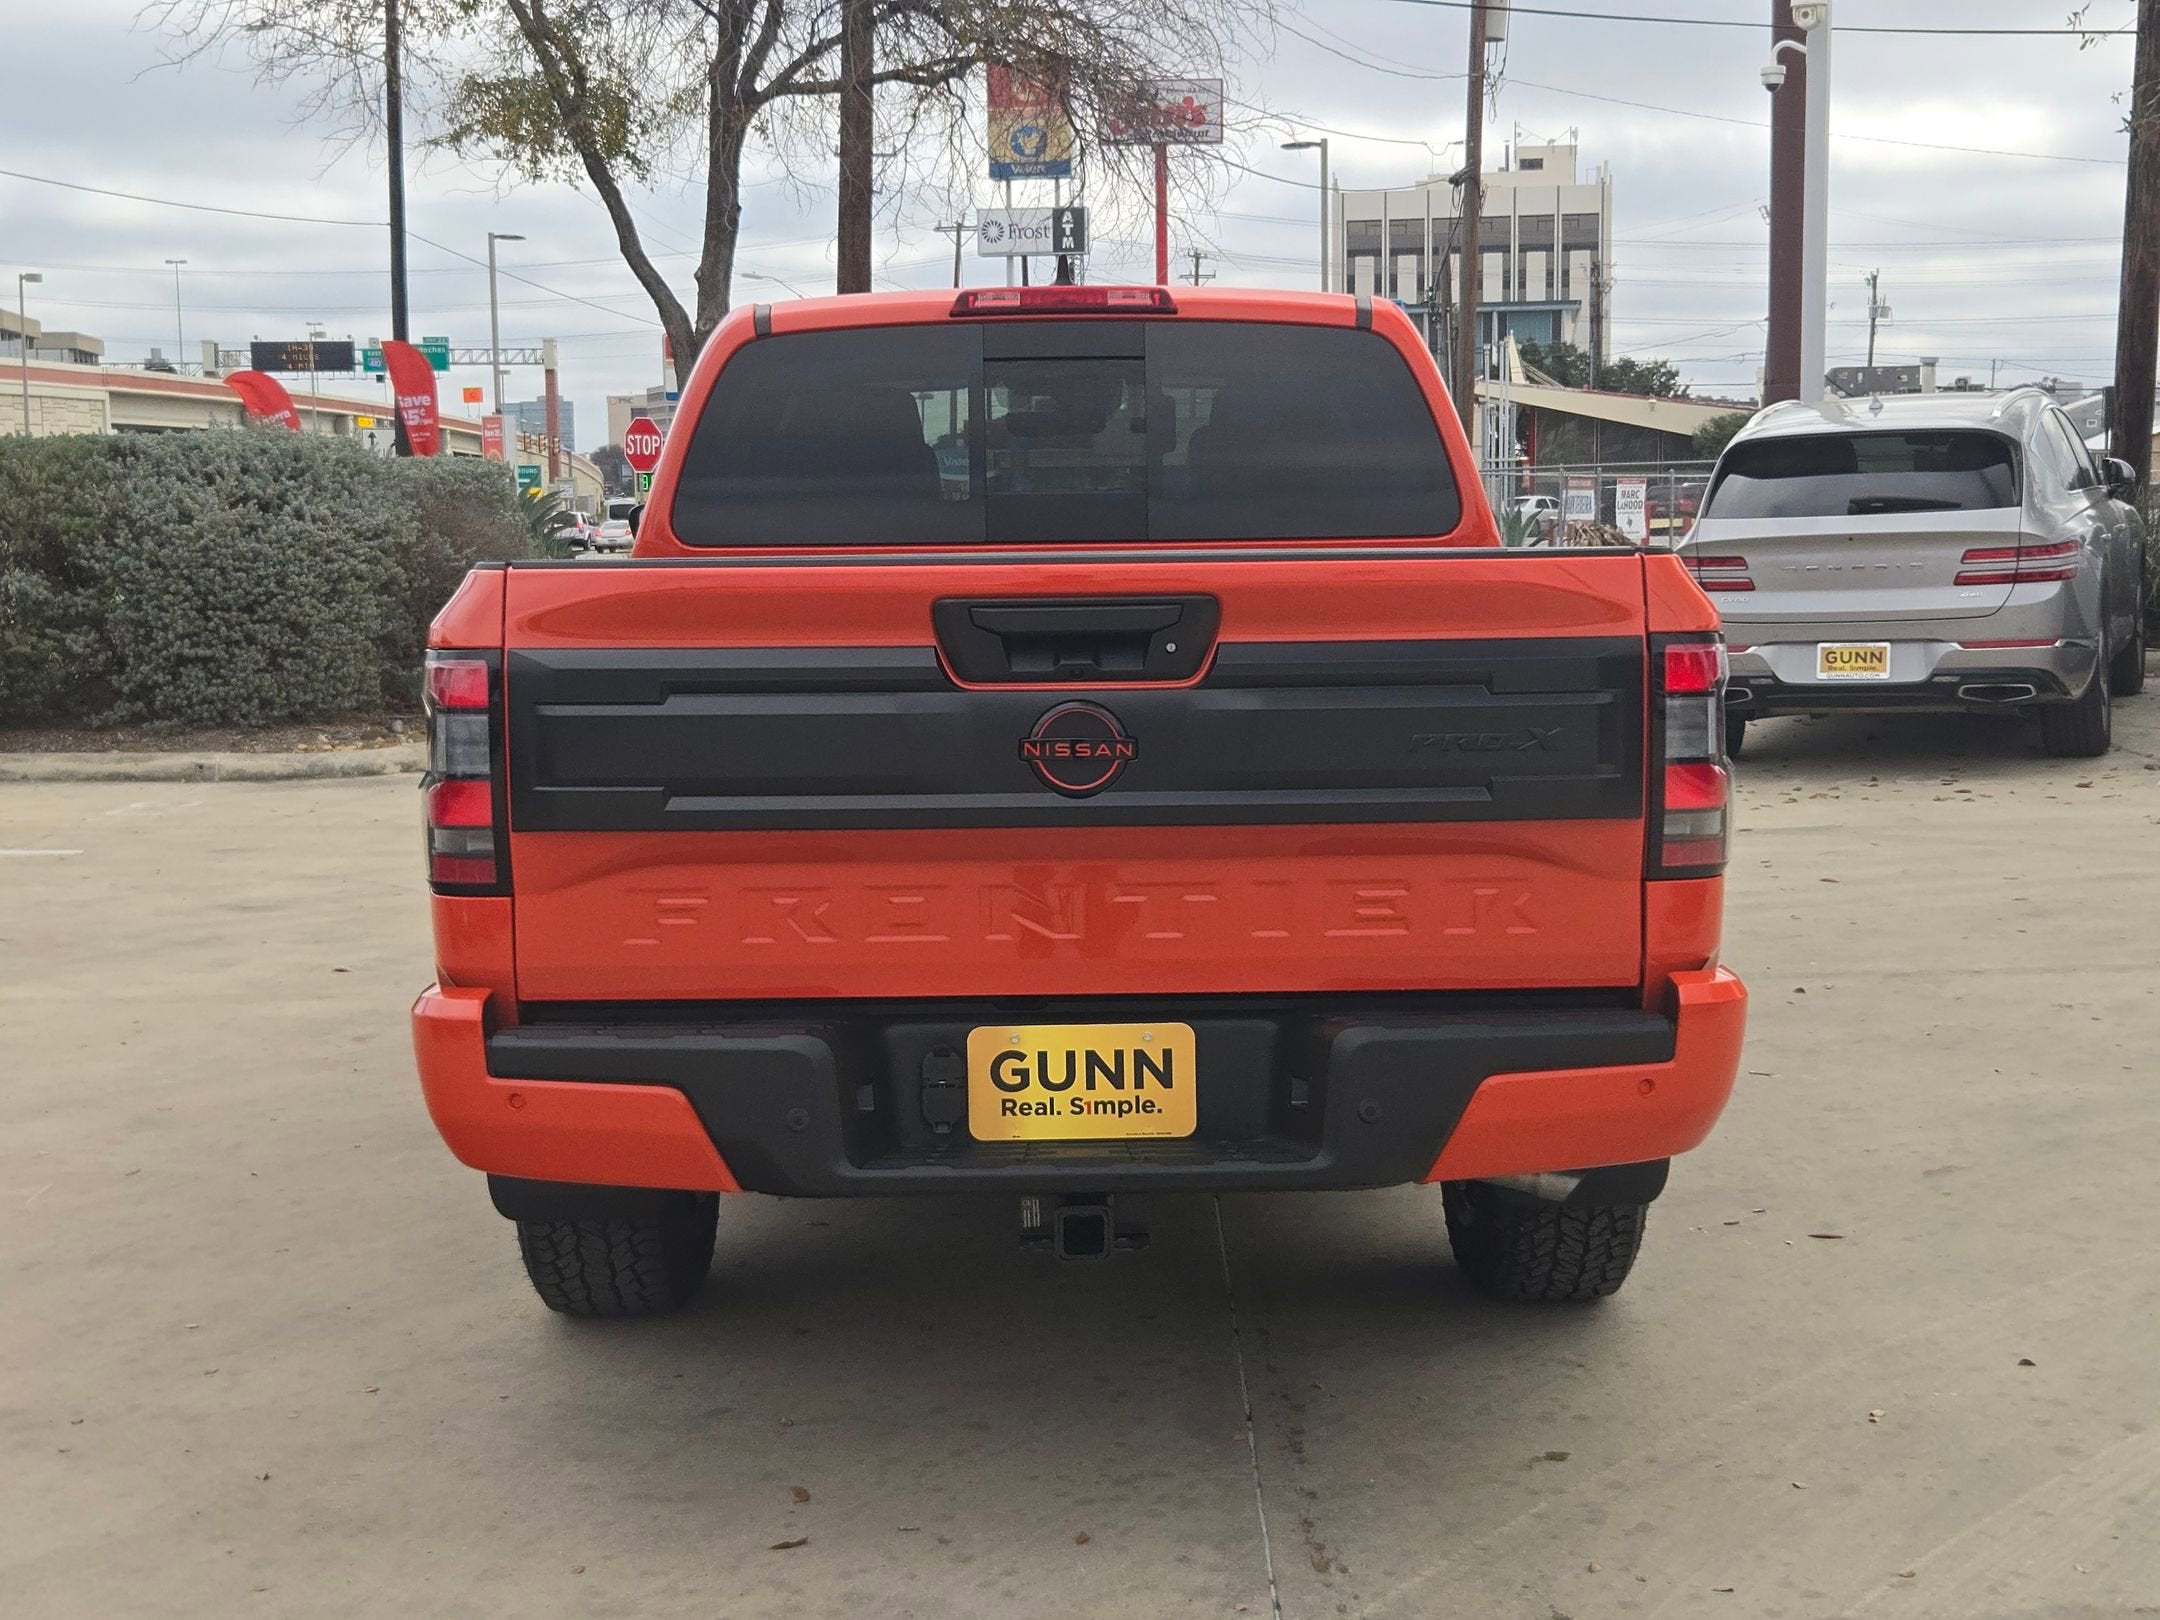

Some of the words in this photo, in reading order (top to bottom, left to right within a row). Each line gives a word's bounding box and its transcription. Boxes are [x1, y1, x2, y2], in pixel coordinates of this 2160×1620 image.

[1008, 223, 1050, 240] Frost
[1062, 210, 1075, 249] ATM
[626, 435, 661, 456] STOP
[1620, 489, 1641, 500] MARC
[1825, 650, 1883, 665] GUNN
[1023, 742, 1133, 757] NISSAN
[620, 876, 1538, 945] FRONTIER
[989, 1047, 1174, 1093] GUNN
[1001, 1096, 1062, 1117] Real.
